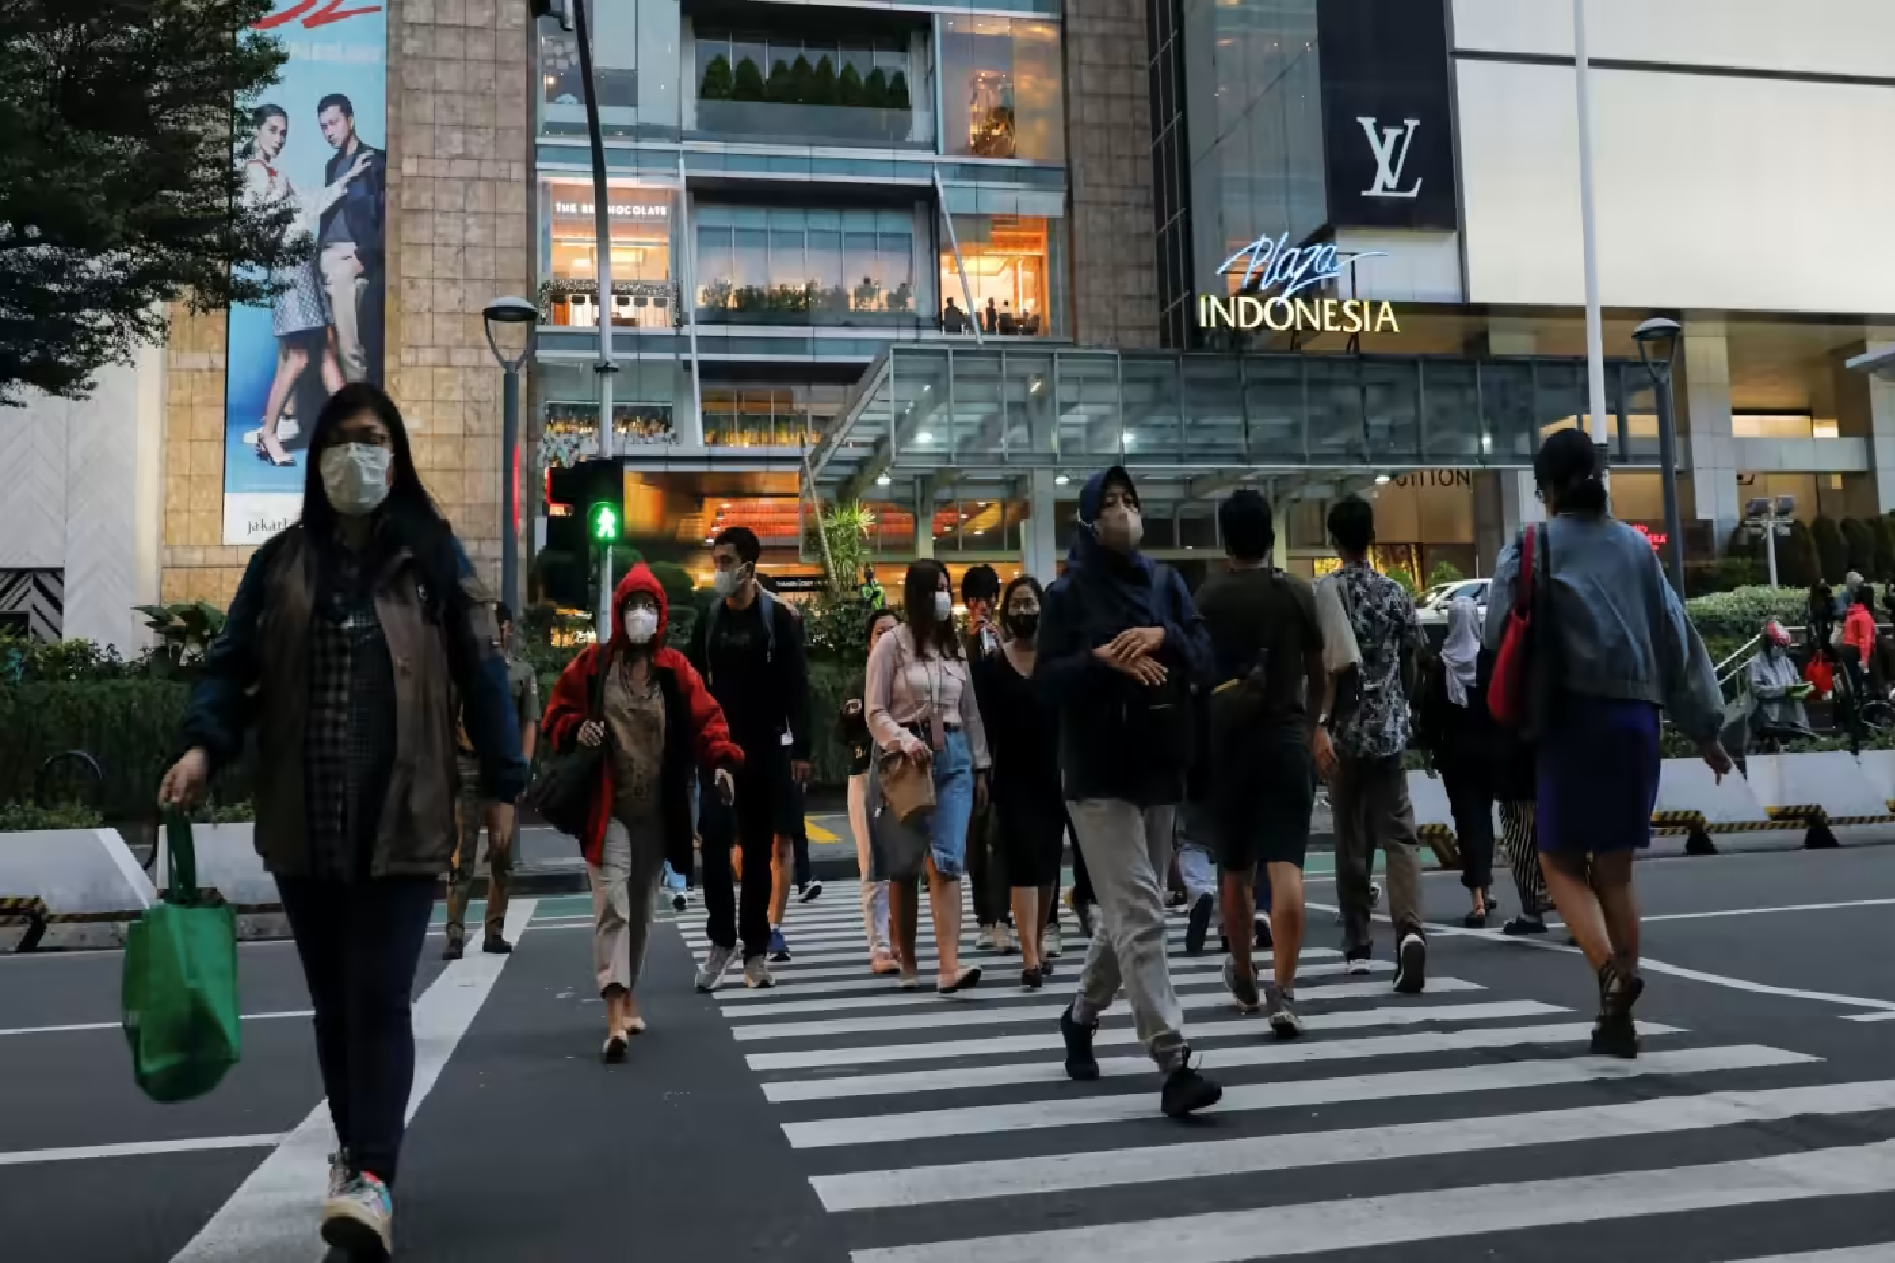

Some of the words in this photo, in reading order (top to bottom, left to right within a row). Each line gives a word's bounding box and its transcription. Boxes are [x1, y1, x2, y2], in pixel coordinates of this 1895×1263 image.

[556, 201, 577, 213] THE
[607, 205, 668, 216] HOCOLATE
[1215, 231, 1388, 306] Plaza
[1199, 295, 1400, 332] INDONESIA
